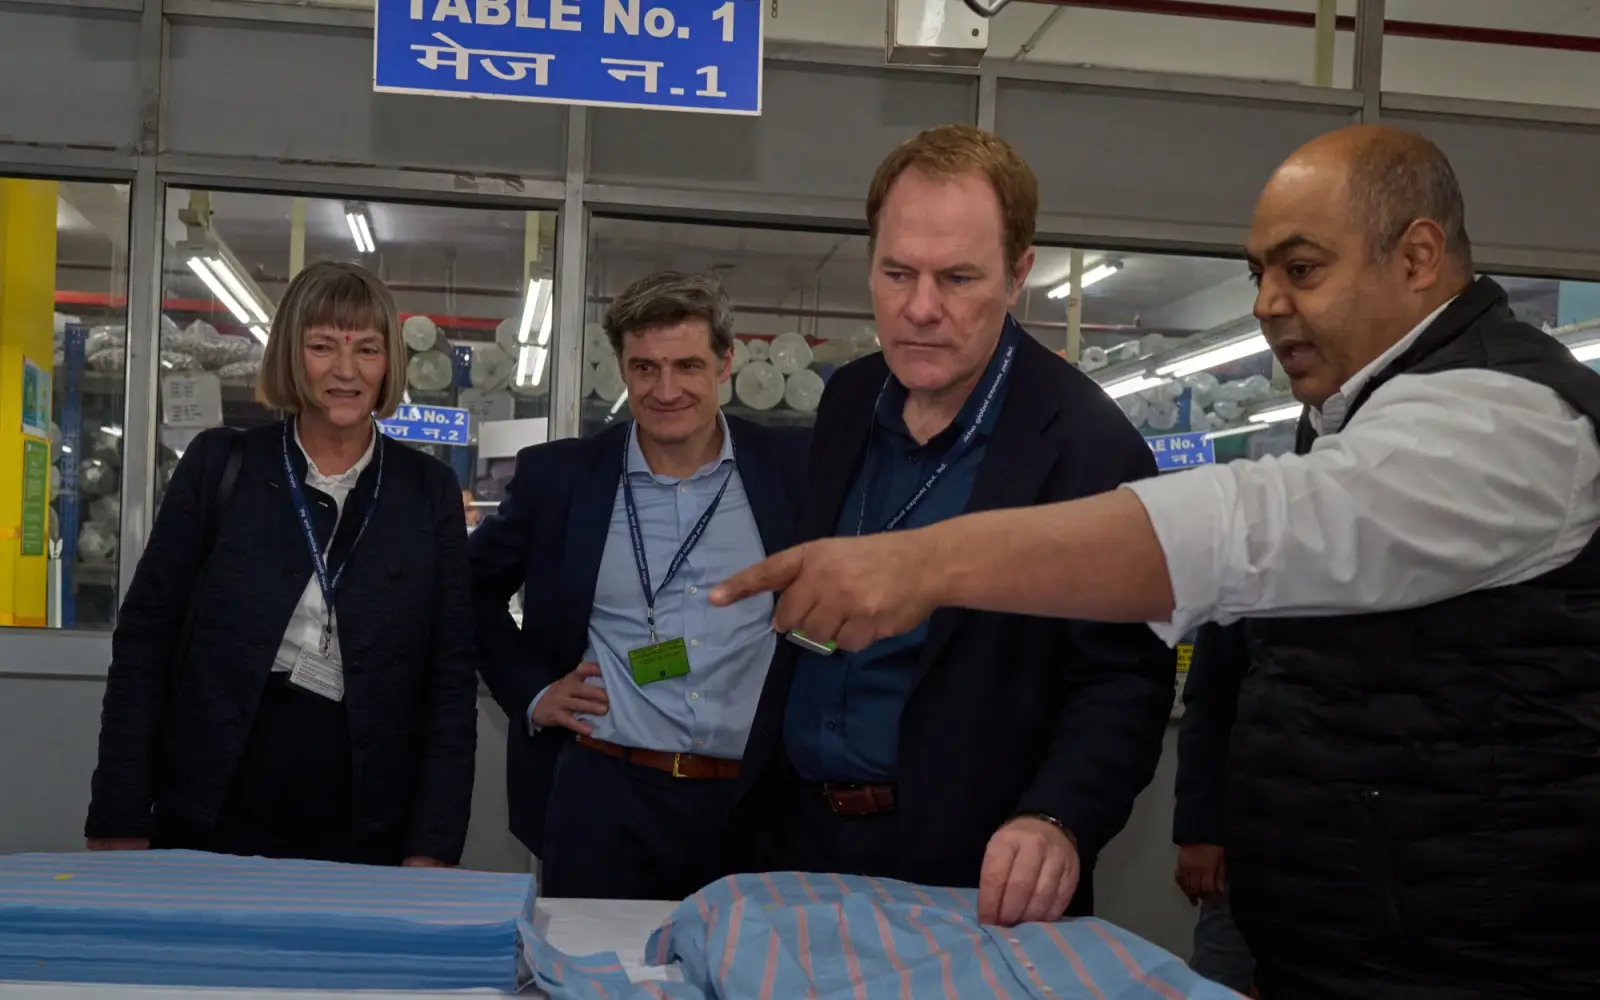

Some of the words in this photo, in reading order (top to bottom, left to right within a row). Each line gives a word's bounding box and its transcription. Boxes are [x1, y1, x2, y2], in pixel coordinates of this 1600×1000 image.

[603, 0, 690, 39] No.
[712, 1, 735, 42] 1
[410, 31, 556, 86] मेज
[600, 57, 727, 98] न.1
[423, 408, 450, 425] No.
[454, 412, 465, 426] 2
[1170, 437, 1195, 451] No.
